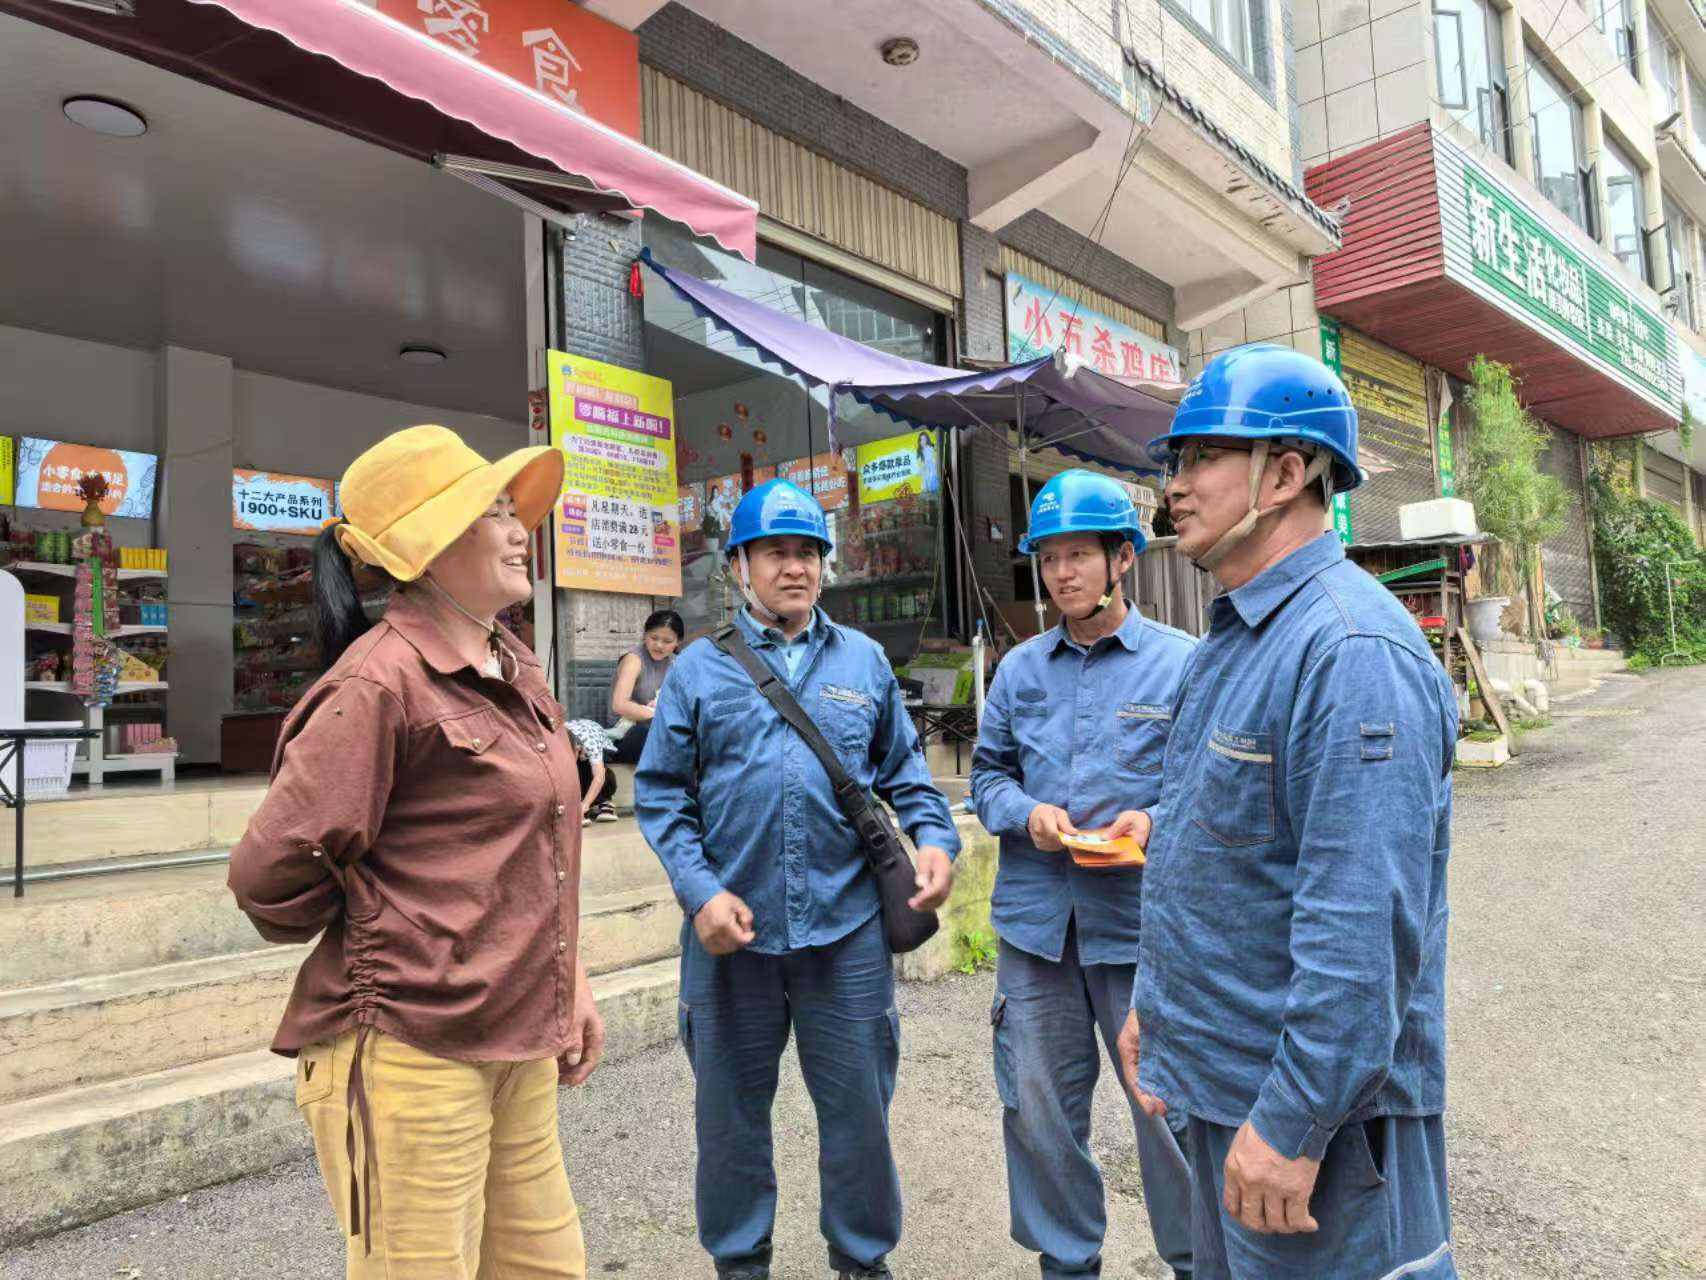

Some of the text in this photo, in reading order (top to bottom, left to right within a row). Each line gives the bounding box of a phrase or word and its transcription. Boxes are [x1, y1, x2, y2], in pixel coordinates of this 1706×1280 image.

[238, 489, 322, 508] 十二大产品系列
[304, 1059, 316, 1082] V
